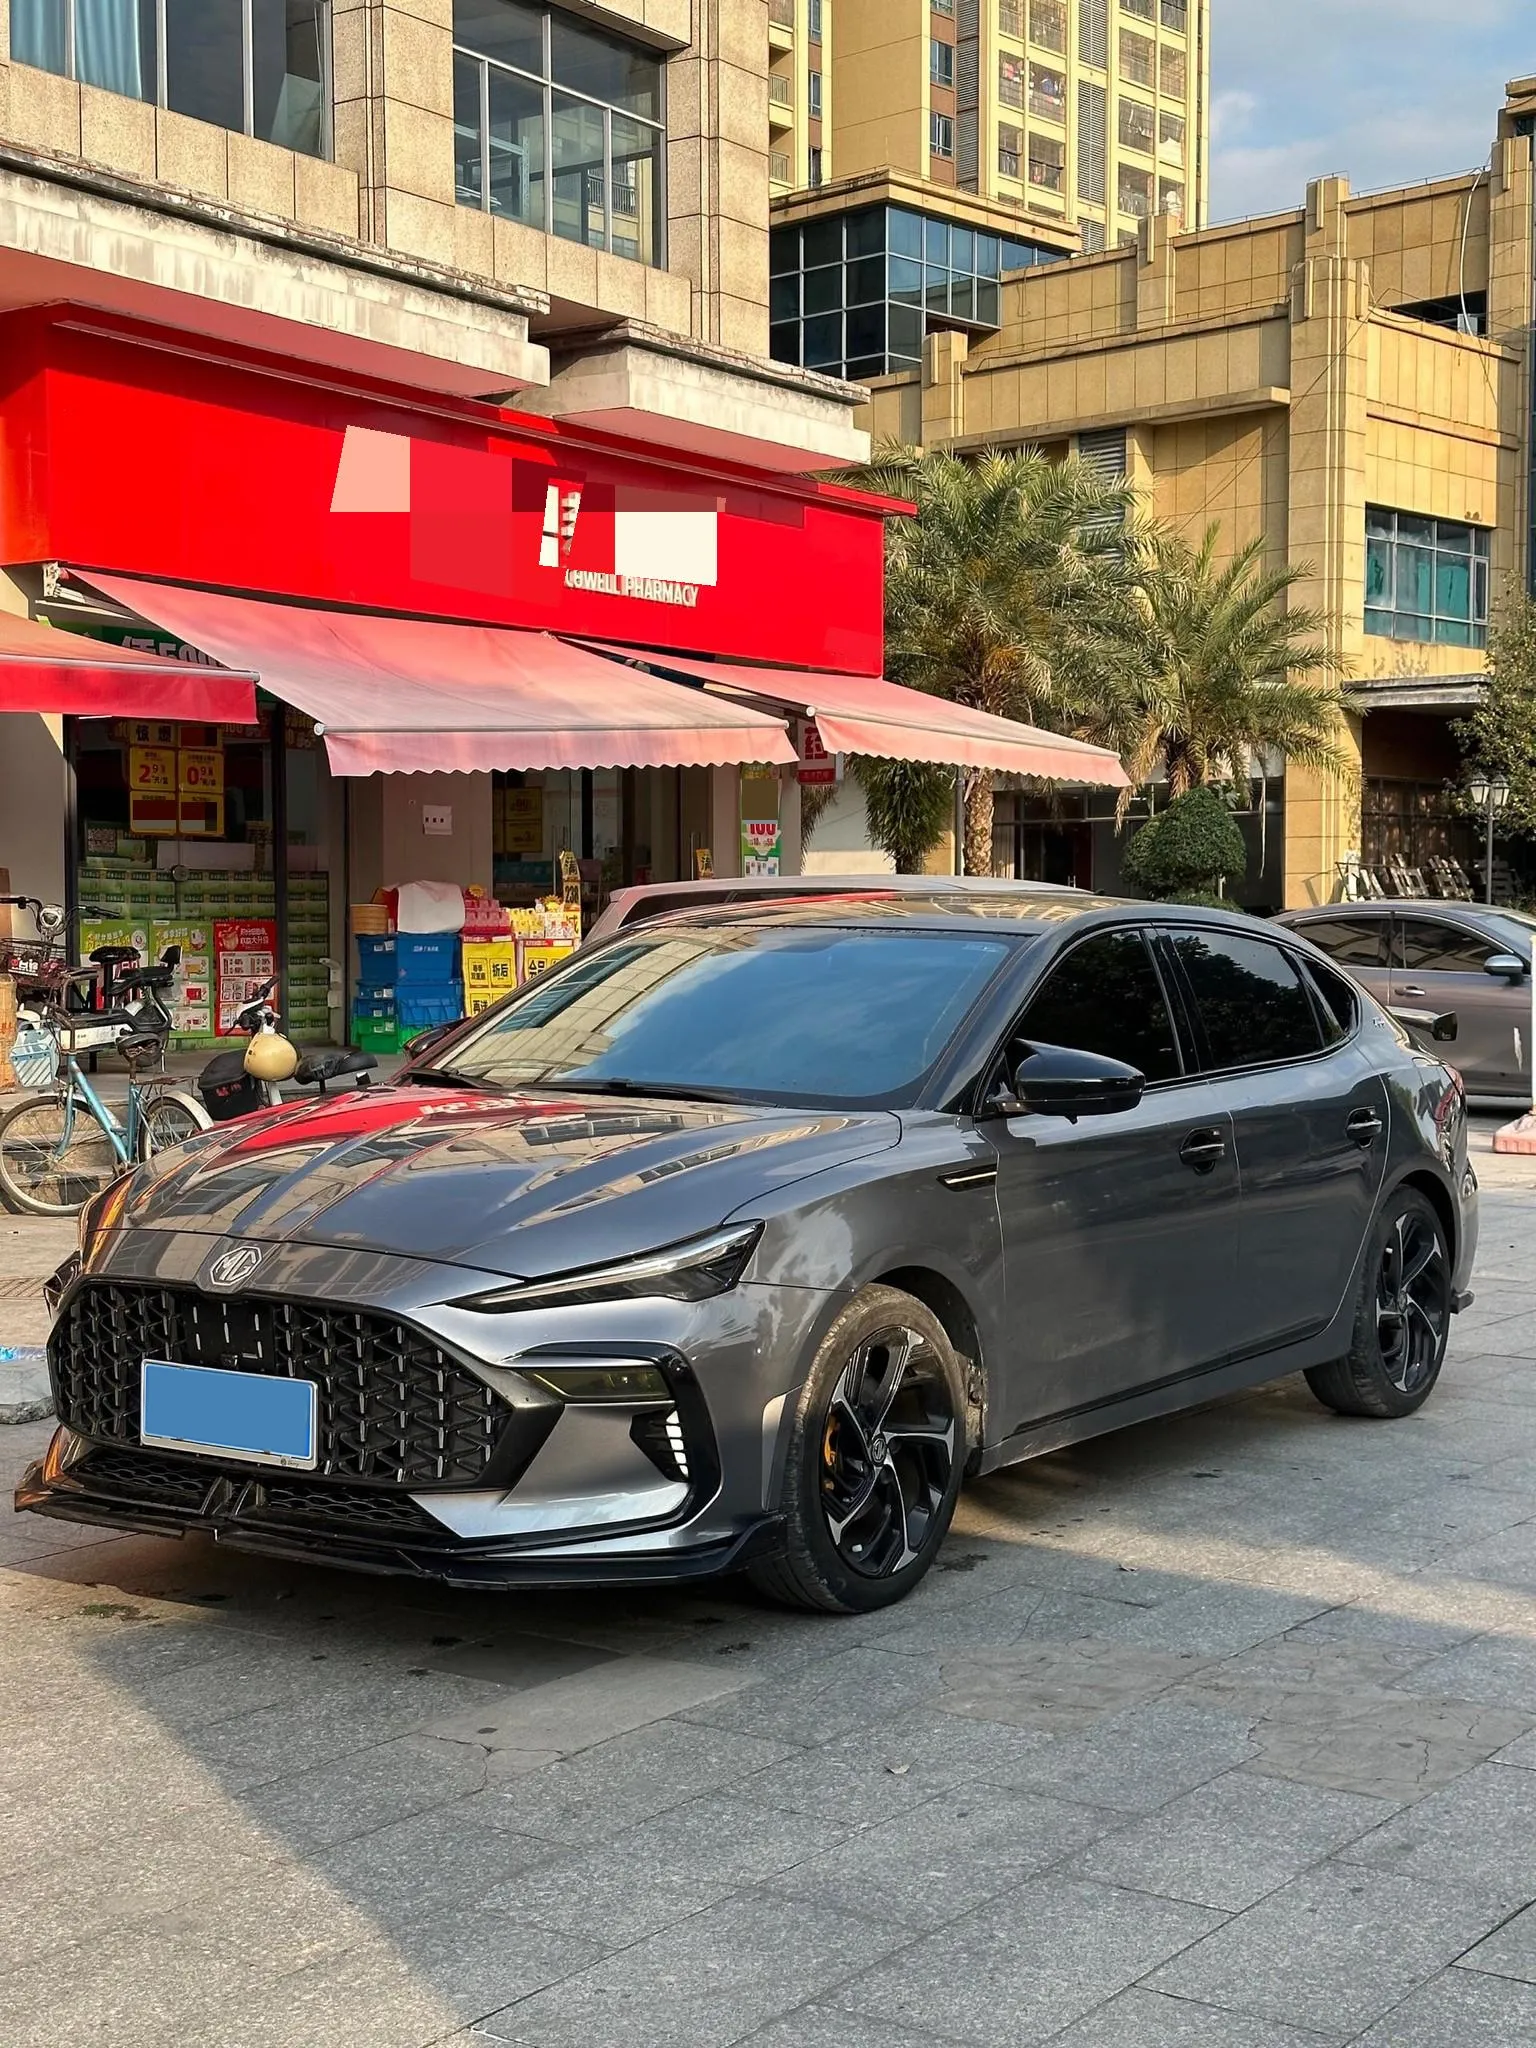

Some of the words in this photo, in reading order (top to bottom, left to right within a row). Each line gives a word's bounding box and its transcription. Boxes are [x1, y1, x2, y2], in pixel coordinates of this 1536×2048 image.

[565, 568, 620, 595] COWELL
[622, 576, 699, 607] PHARMACY
[213, 1248, 259, 1283] MG
